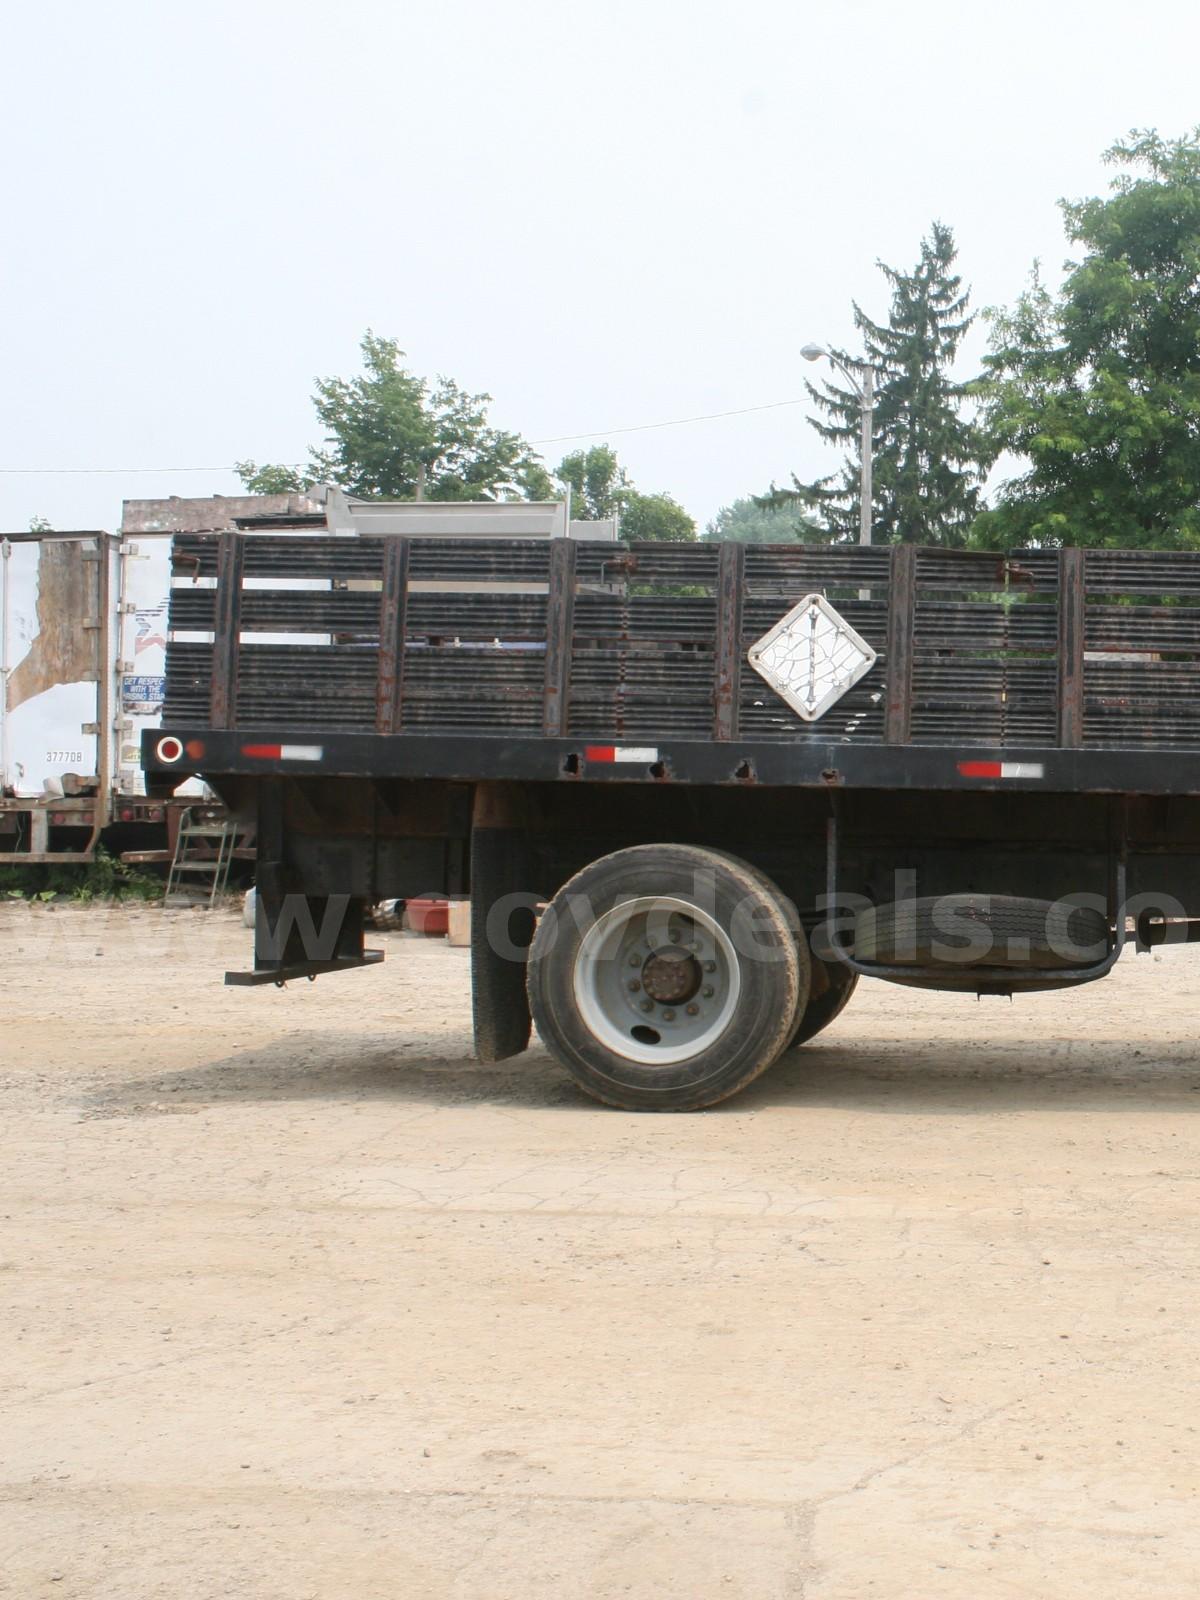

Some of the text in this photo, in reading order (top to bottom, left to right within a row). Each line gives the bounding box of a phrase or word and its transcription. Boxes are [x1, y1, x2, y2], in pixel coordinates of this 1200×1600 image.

[130, 685, 161, 693] WITH THE
[46, 751, 82, 762] 377708
